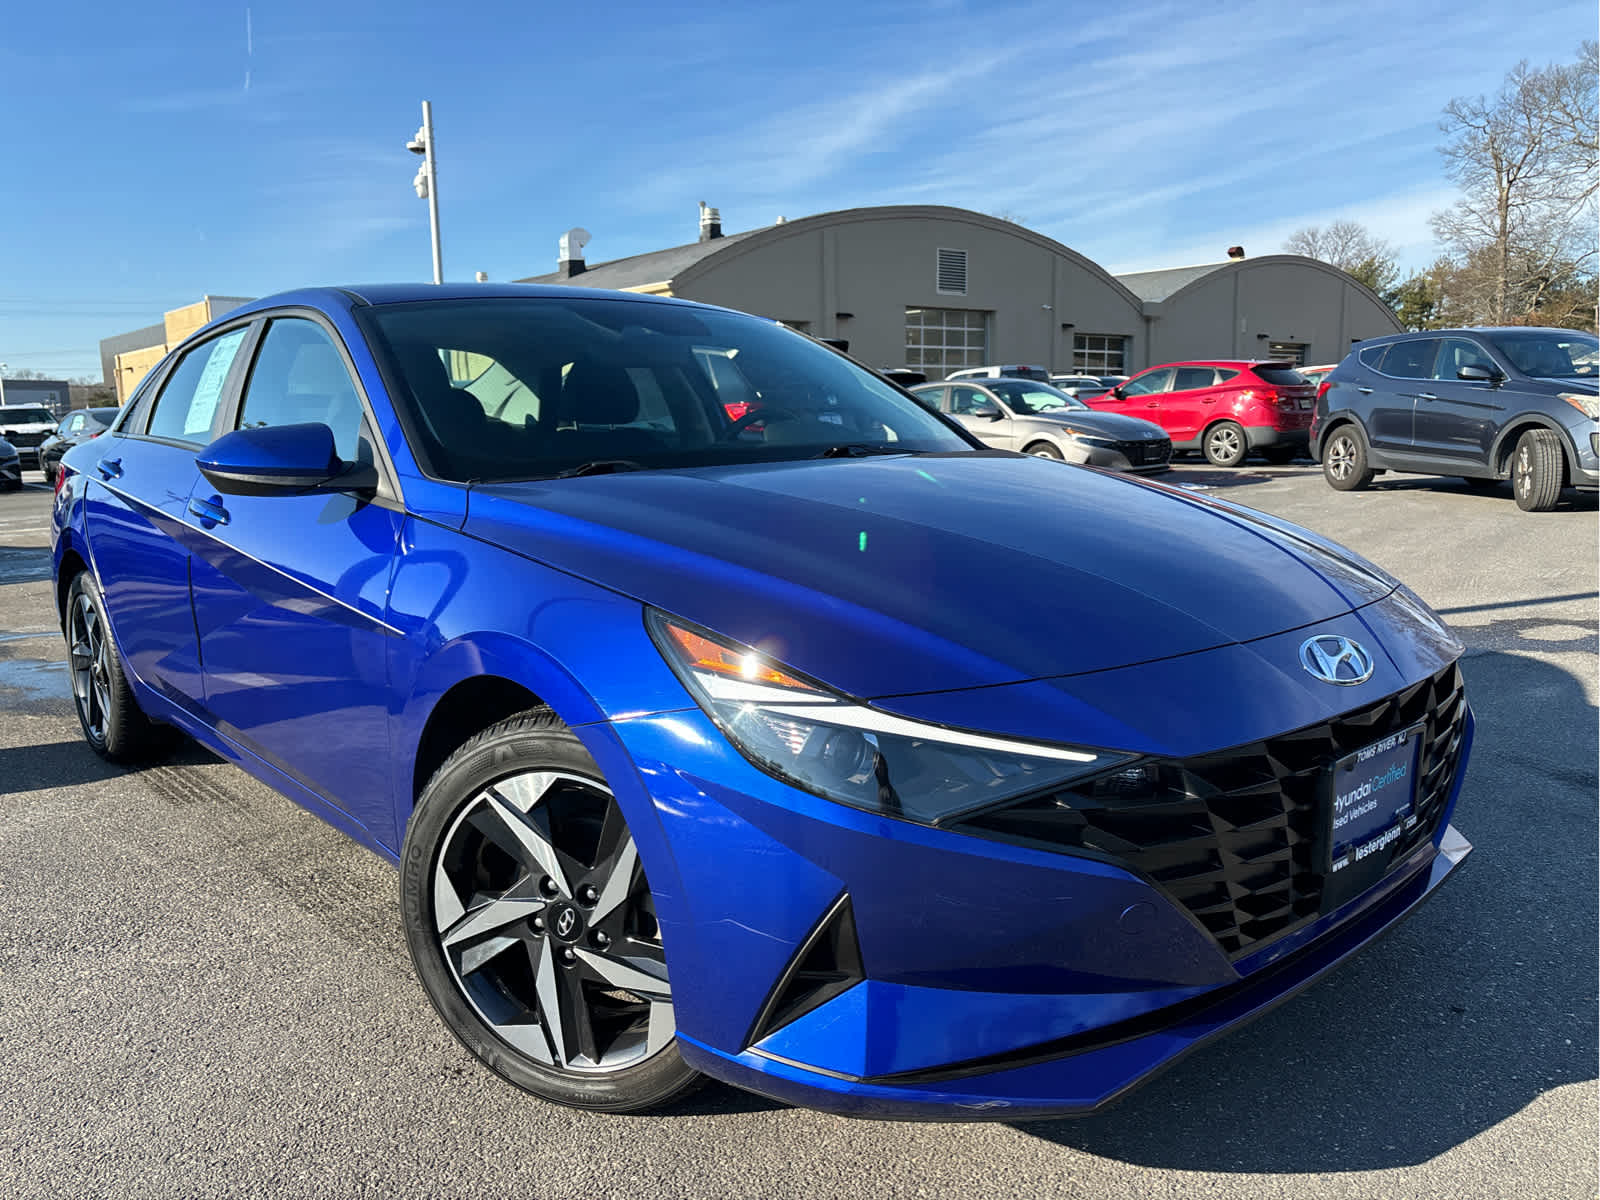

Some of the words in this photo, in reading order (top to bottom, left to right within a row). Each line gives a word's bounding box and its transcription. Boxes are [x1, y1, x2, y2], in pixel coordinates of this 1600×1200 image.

[1357, 746, 1377, 763] TOMS
[1371, 760, 1407, 792] Certified
[1349, 798, 1377, 821] Vehicles
[1355, 825, 1401, 862] lesterglenn
